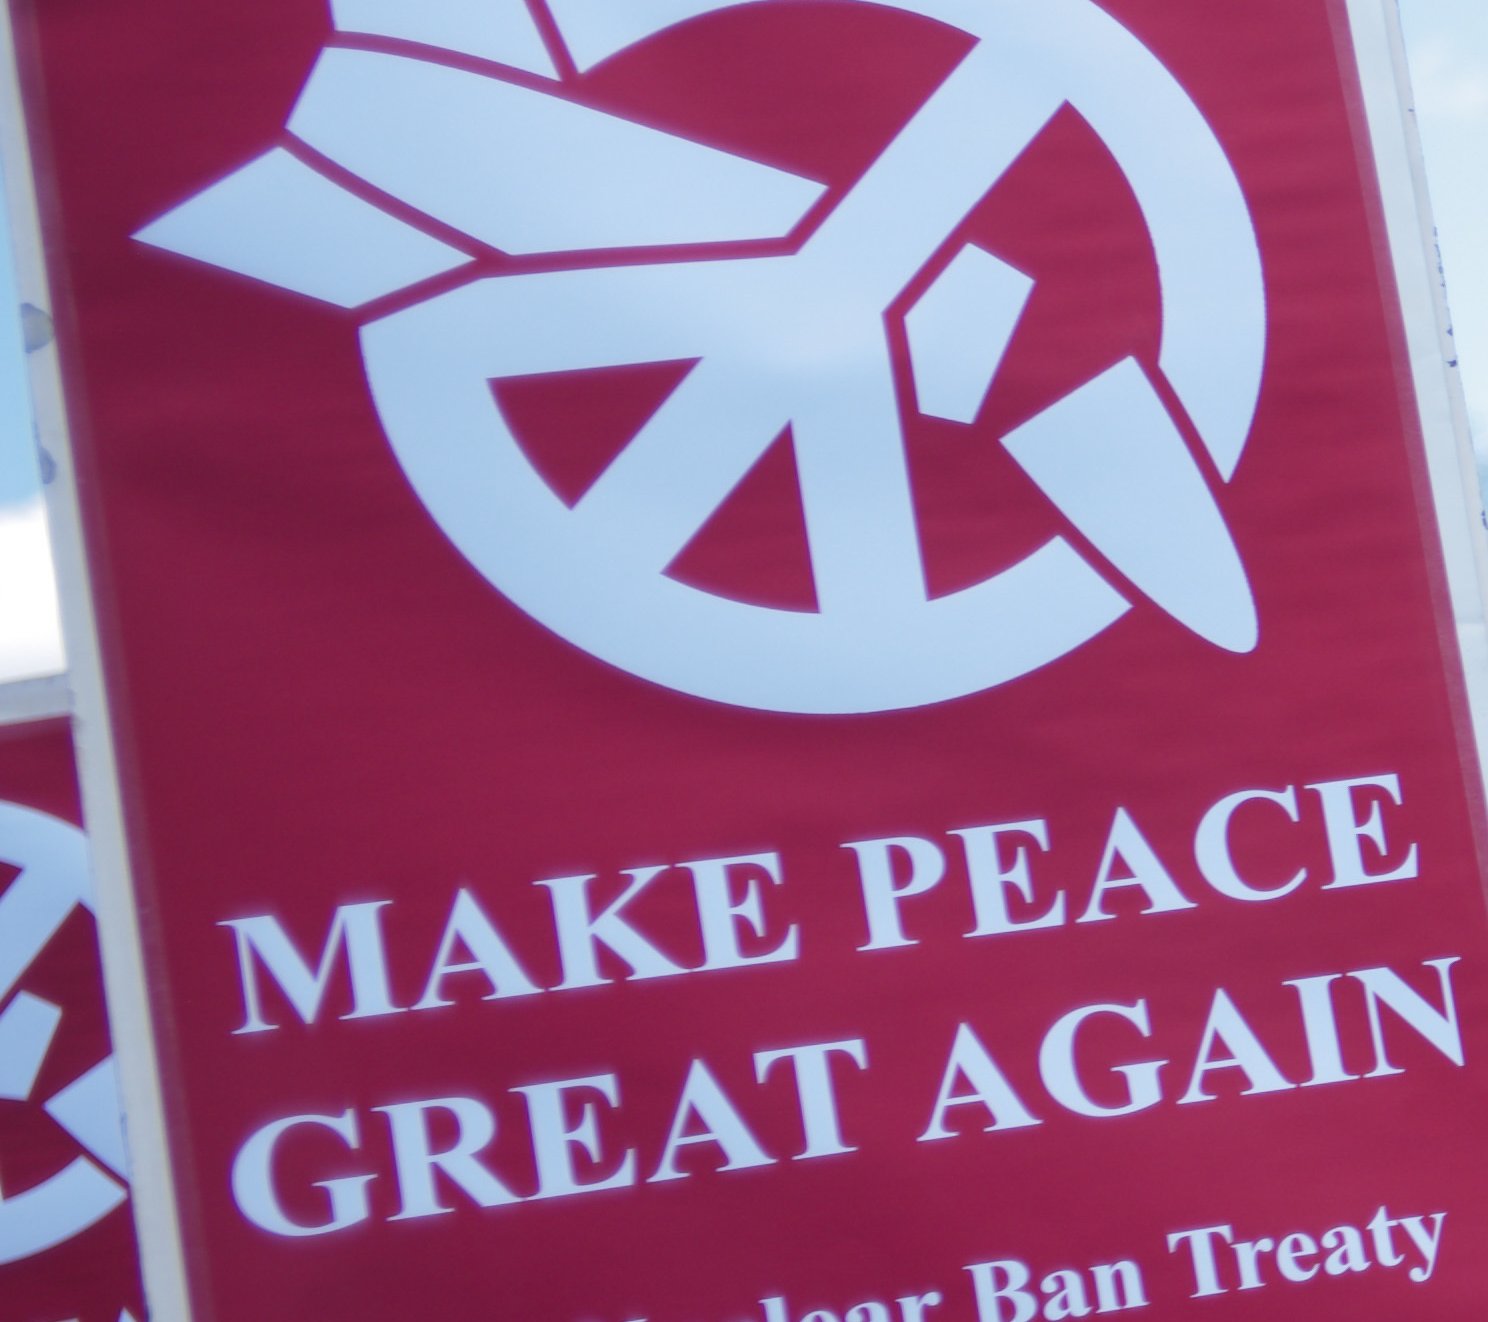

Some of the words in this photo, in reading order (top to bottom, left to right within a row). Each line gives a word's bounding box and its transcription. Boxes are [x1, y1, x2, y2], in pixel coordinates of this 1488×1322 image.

[218, 851, 799, 1035] MAKE
[840, 773, 1420, 952] PEACE
[232, 1038, 868, 1237] GREAT
[916, 955, 1467, 1143] AGAIN
[1166, 1204, 1448, 1299] Treaty
